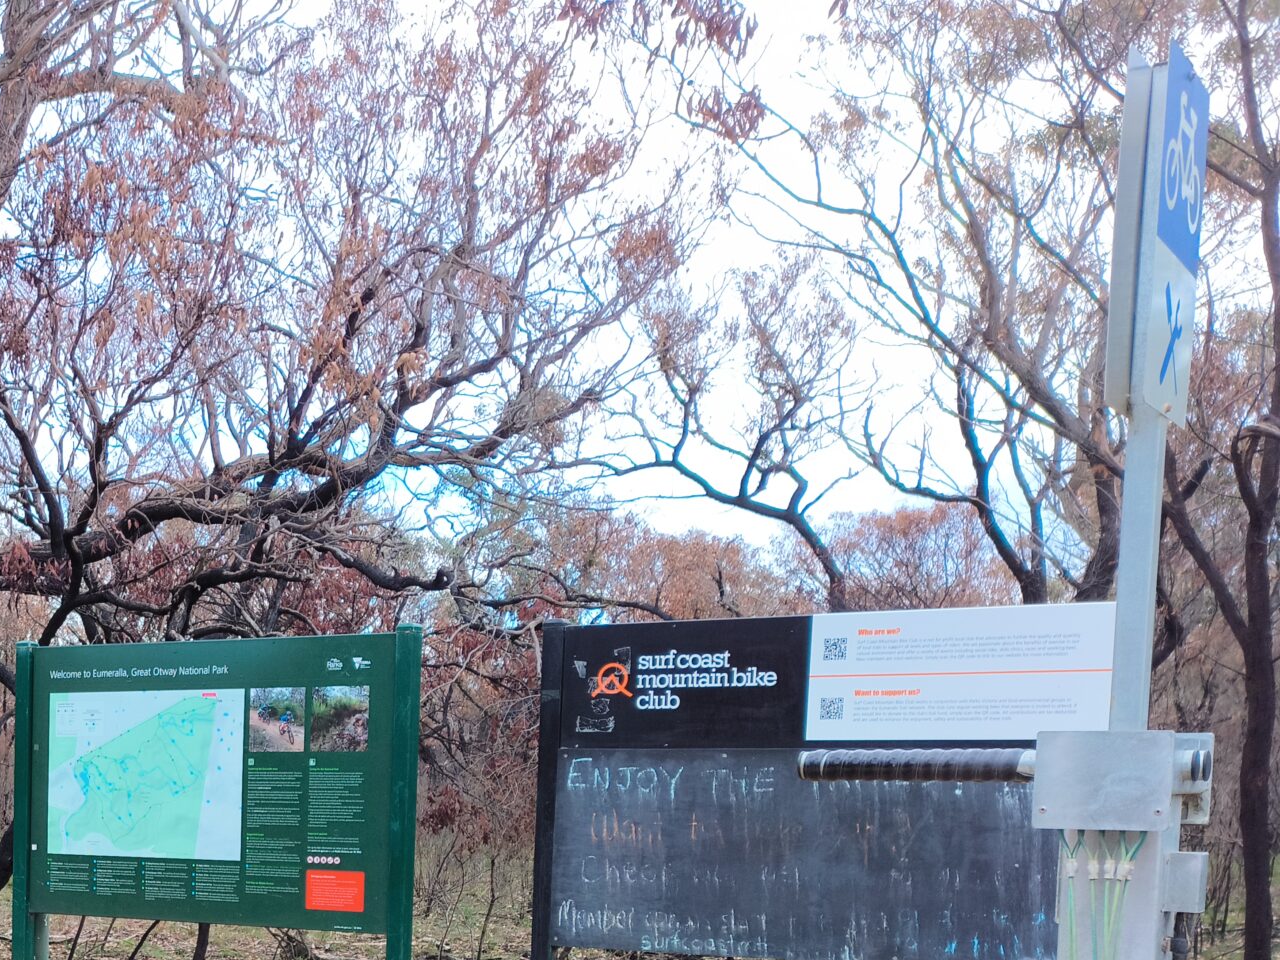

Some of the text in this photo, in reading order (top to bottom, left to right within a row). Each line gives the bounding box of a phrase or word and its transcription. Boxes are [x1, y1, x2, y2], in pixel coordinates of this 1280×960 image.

[638, 650, 730, 669] surf coast
[50, 664, 229, 679] Welcome to Eumeralla, Great Otway National Park
[636, 667, 778, 688] mountain bike
[636, 690, 680, 709] club
[702, 766, 775, 796] THE
